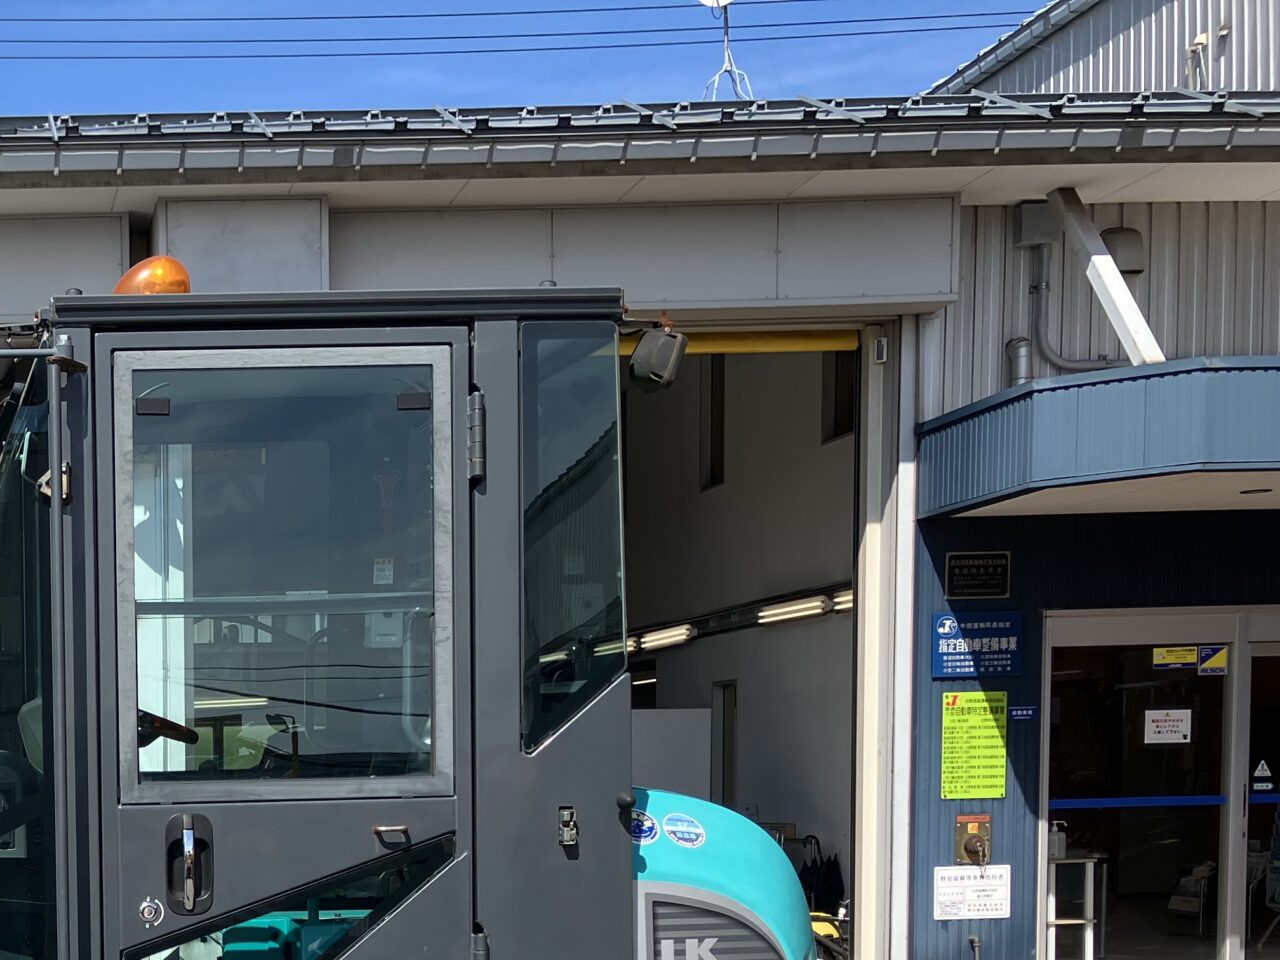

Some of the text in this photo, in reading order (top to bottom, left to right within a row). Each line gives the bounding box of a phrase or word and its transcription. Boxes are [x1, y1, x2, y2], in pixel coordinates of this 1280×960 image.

[938, 636, 1018, 653] 指定自動車整備事業
